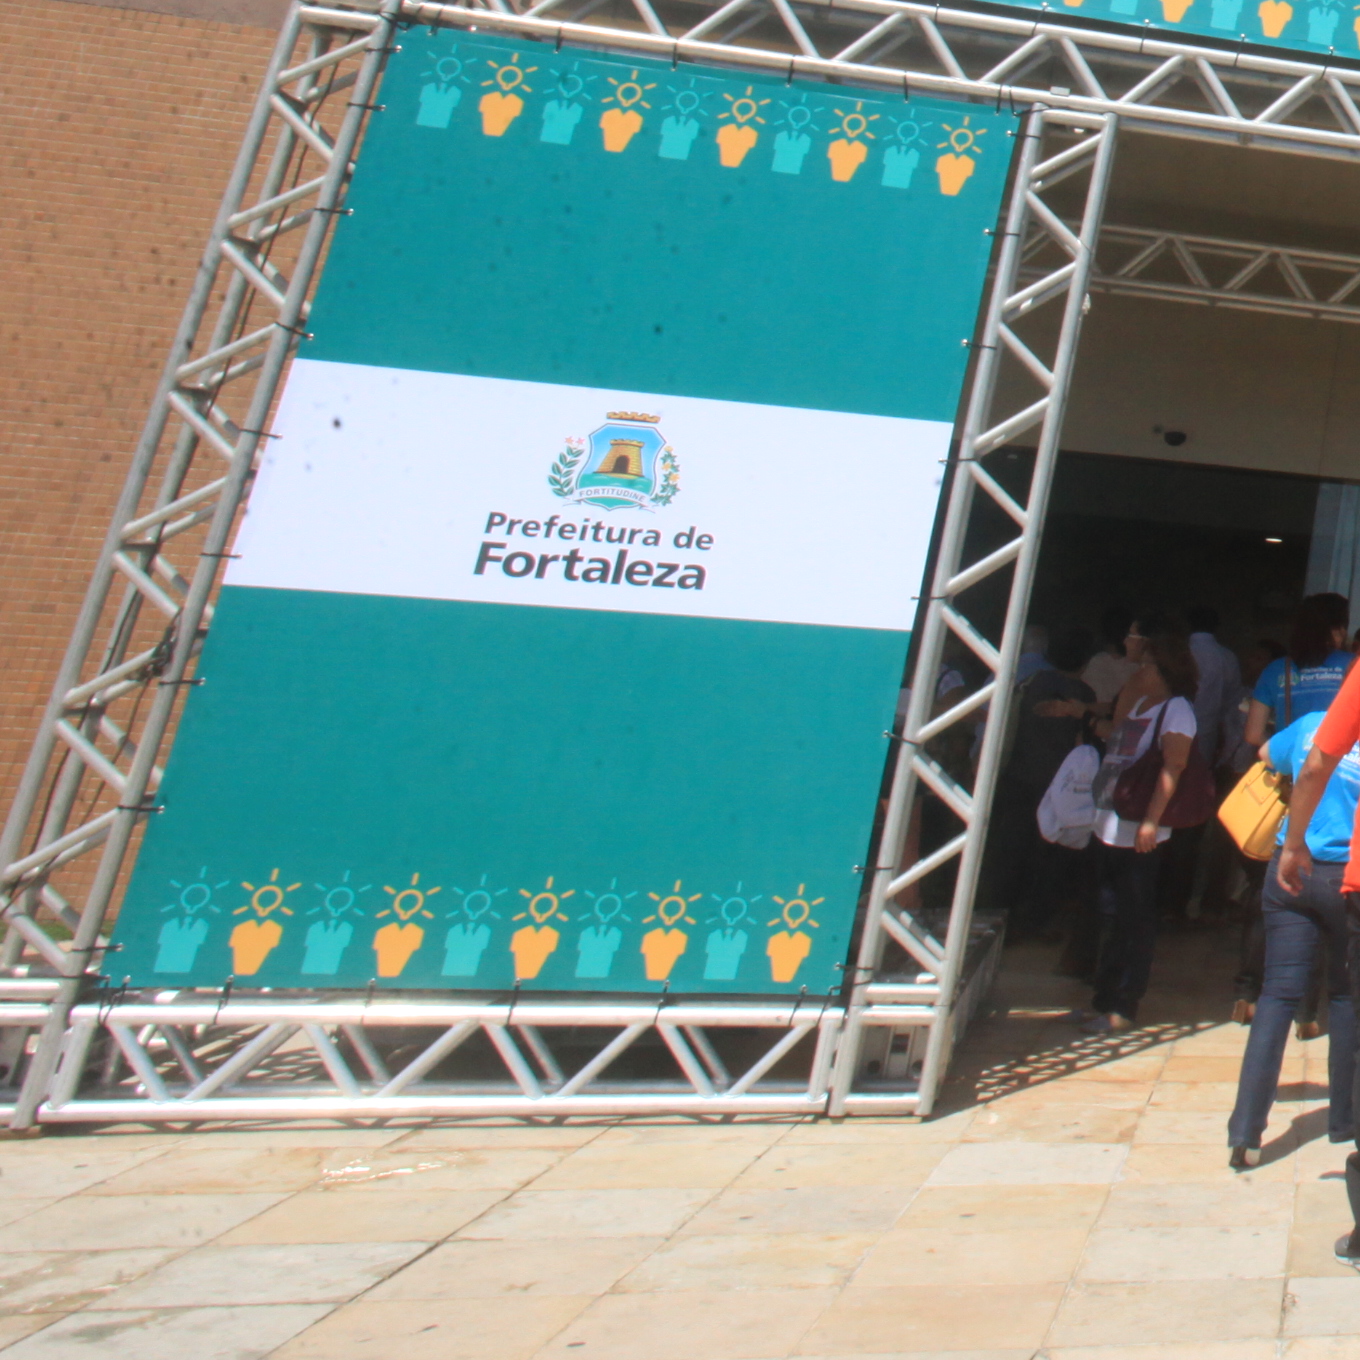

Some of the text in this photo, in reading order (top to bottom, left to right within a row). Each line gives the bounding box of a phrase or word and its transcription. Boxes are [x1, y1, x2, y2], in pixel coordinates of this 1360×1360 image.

[579, 488, 646, 501] FORTITUDINE
[484, 511, 714, 550] Prefeitura de
[473, 541, 708, 590] Fortaleza
